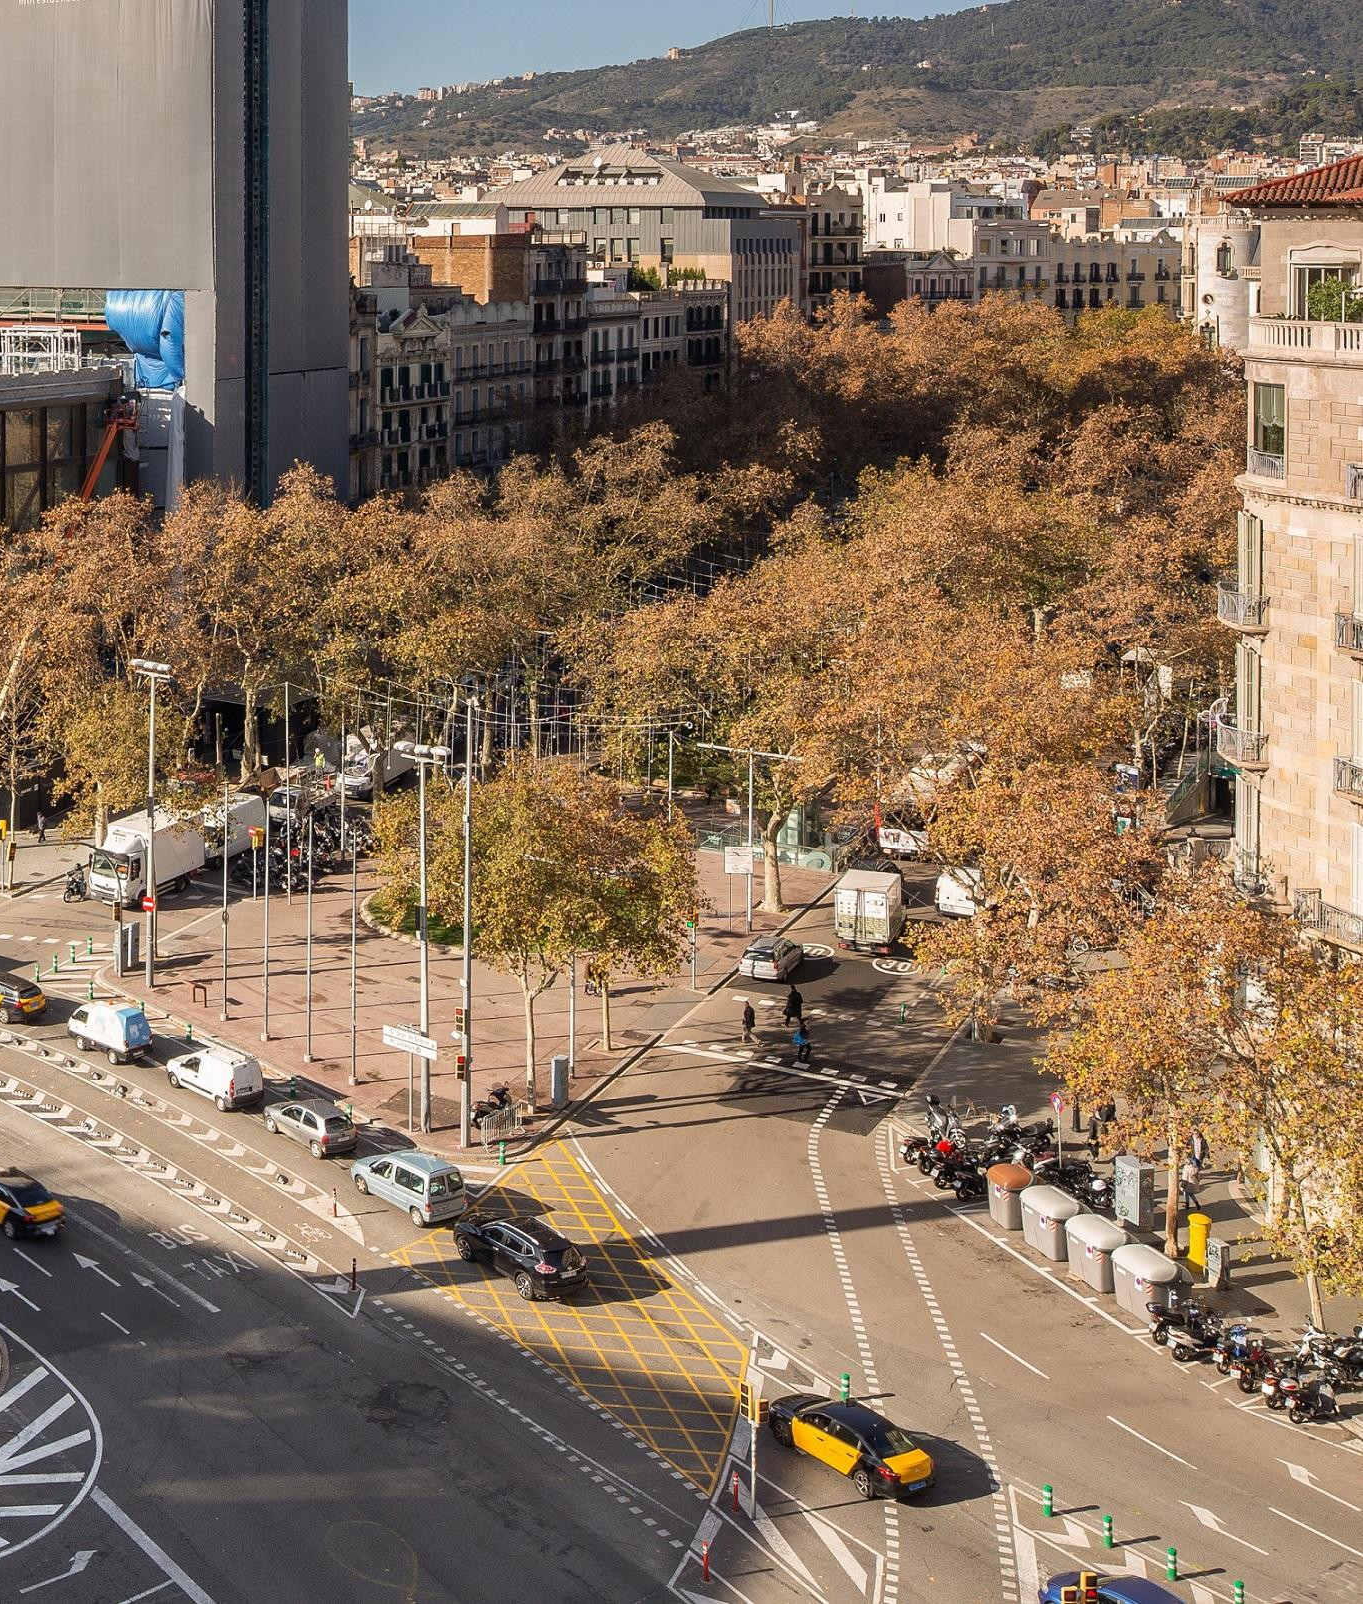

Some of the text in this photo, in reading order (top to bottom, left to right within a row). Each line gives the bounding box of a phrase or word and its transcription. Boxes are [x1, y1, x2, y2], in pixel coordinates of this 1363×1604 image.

[881, 959, 912, 972] 30
[147, 1224, 210, 1250] BUS
[182, 1250, 259, 1280] TAXI
